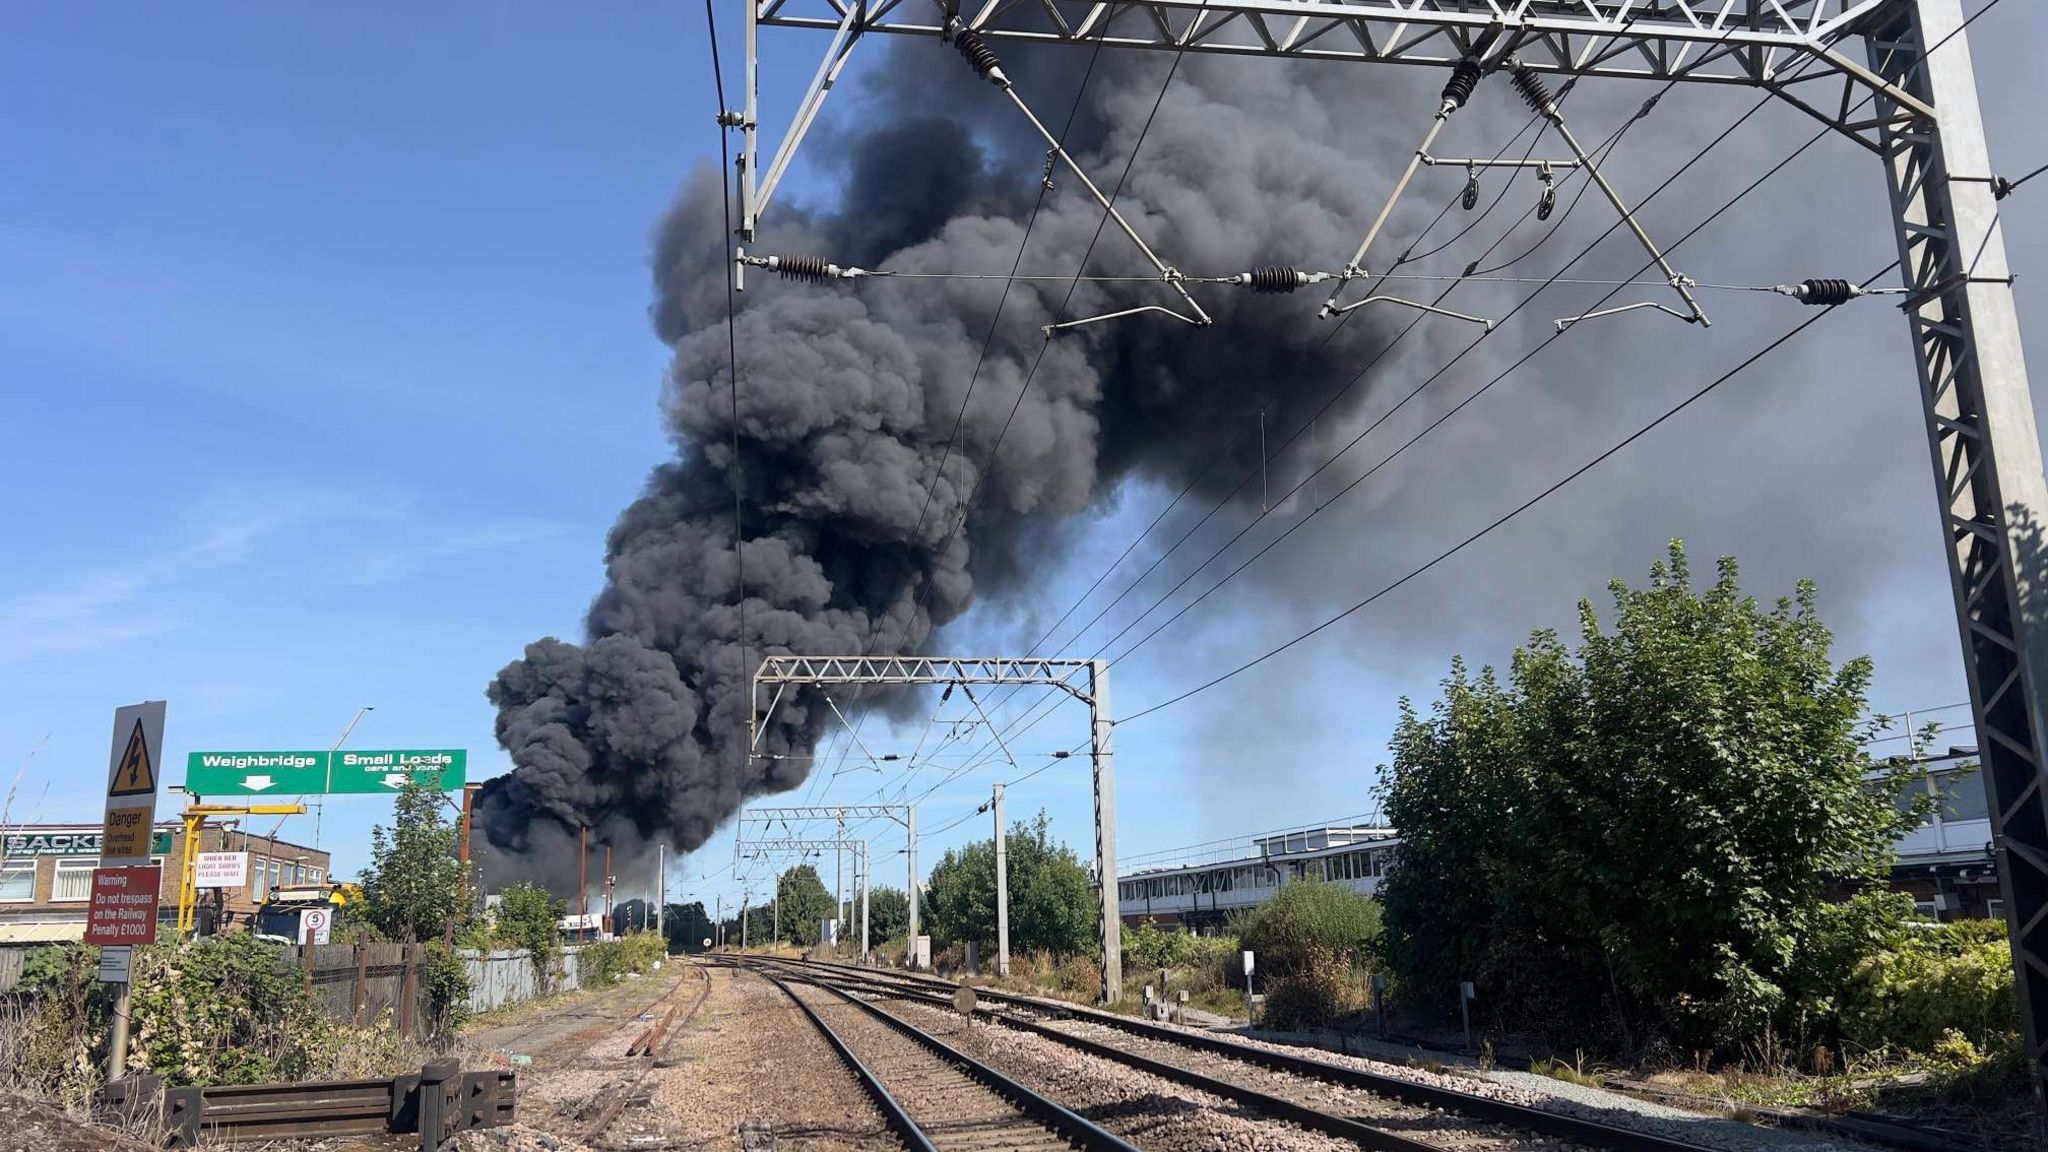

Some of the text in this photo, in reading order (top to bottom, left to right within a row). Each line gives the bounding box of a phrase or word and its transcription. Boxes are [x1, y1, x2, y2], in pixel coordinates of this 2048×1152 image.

[202, 755, 316, 769] Weighbridge
[343, 753, 452, 766] Small Loads
[109, 811, 142, 828] Danger
[97, 874, 128, 887] Warning
[95, 893, 153, 906] Do not trespass
[93, 908, 147, 922] on the Railway
[312, 914, 319, 923] 5
[91, 923, 146, 938] Penalty £1000
